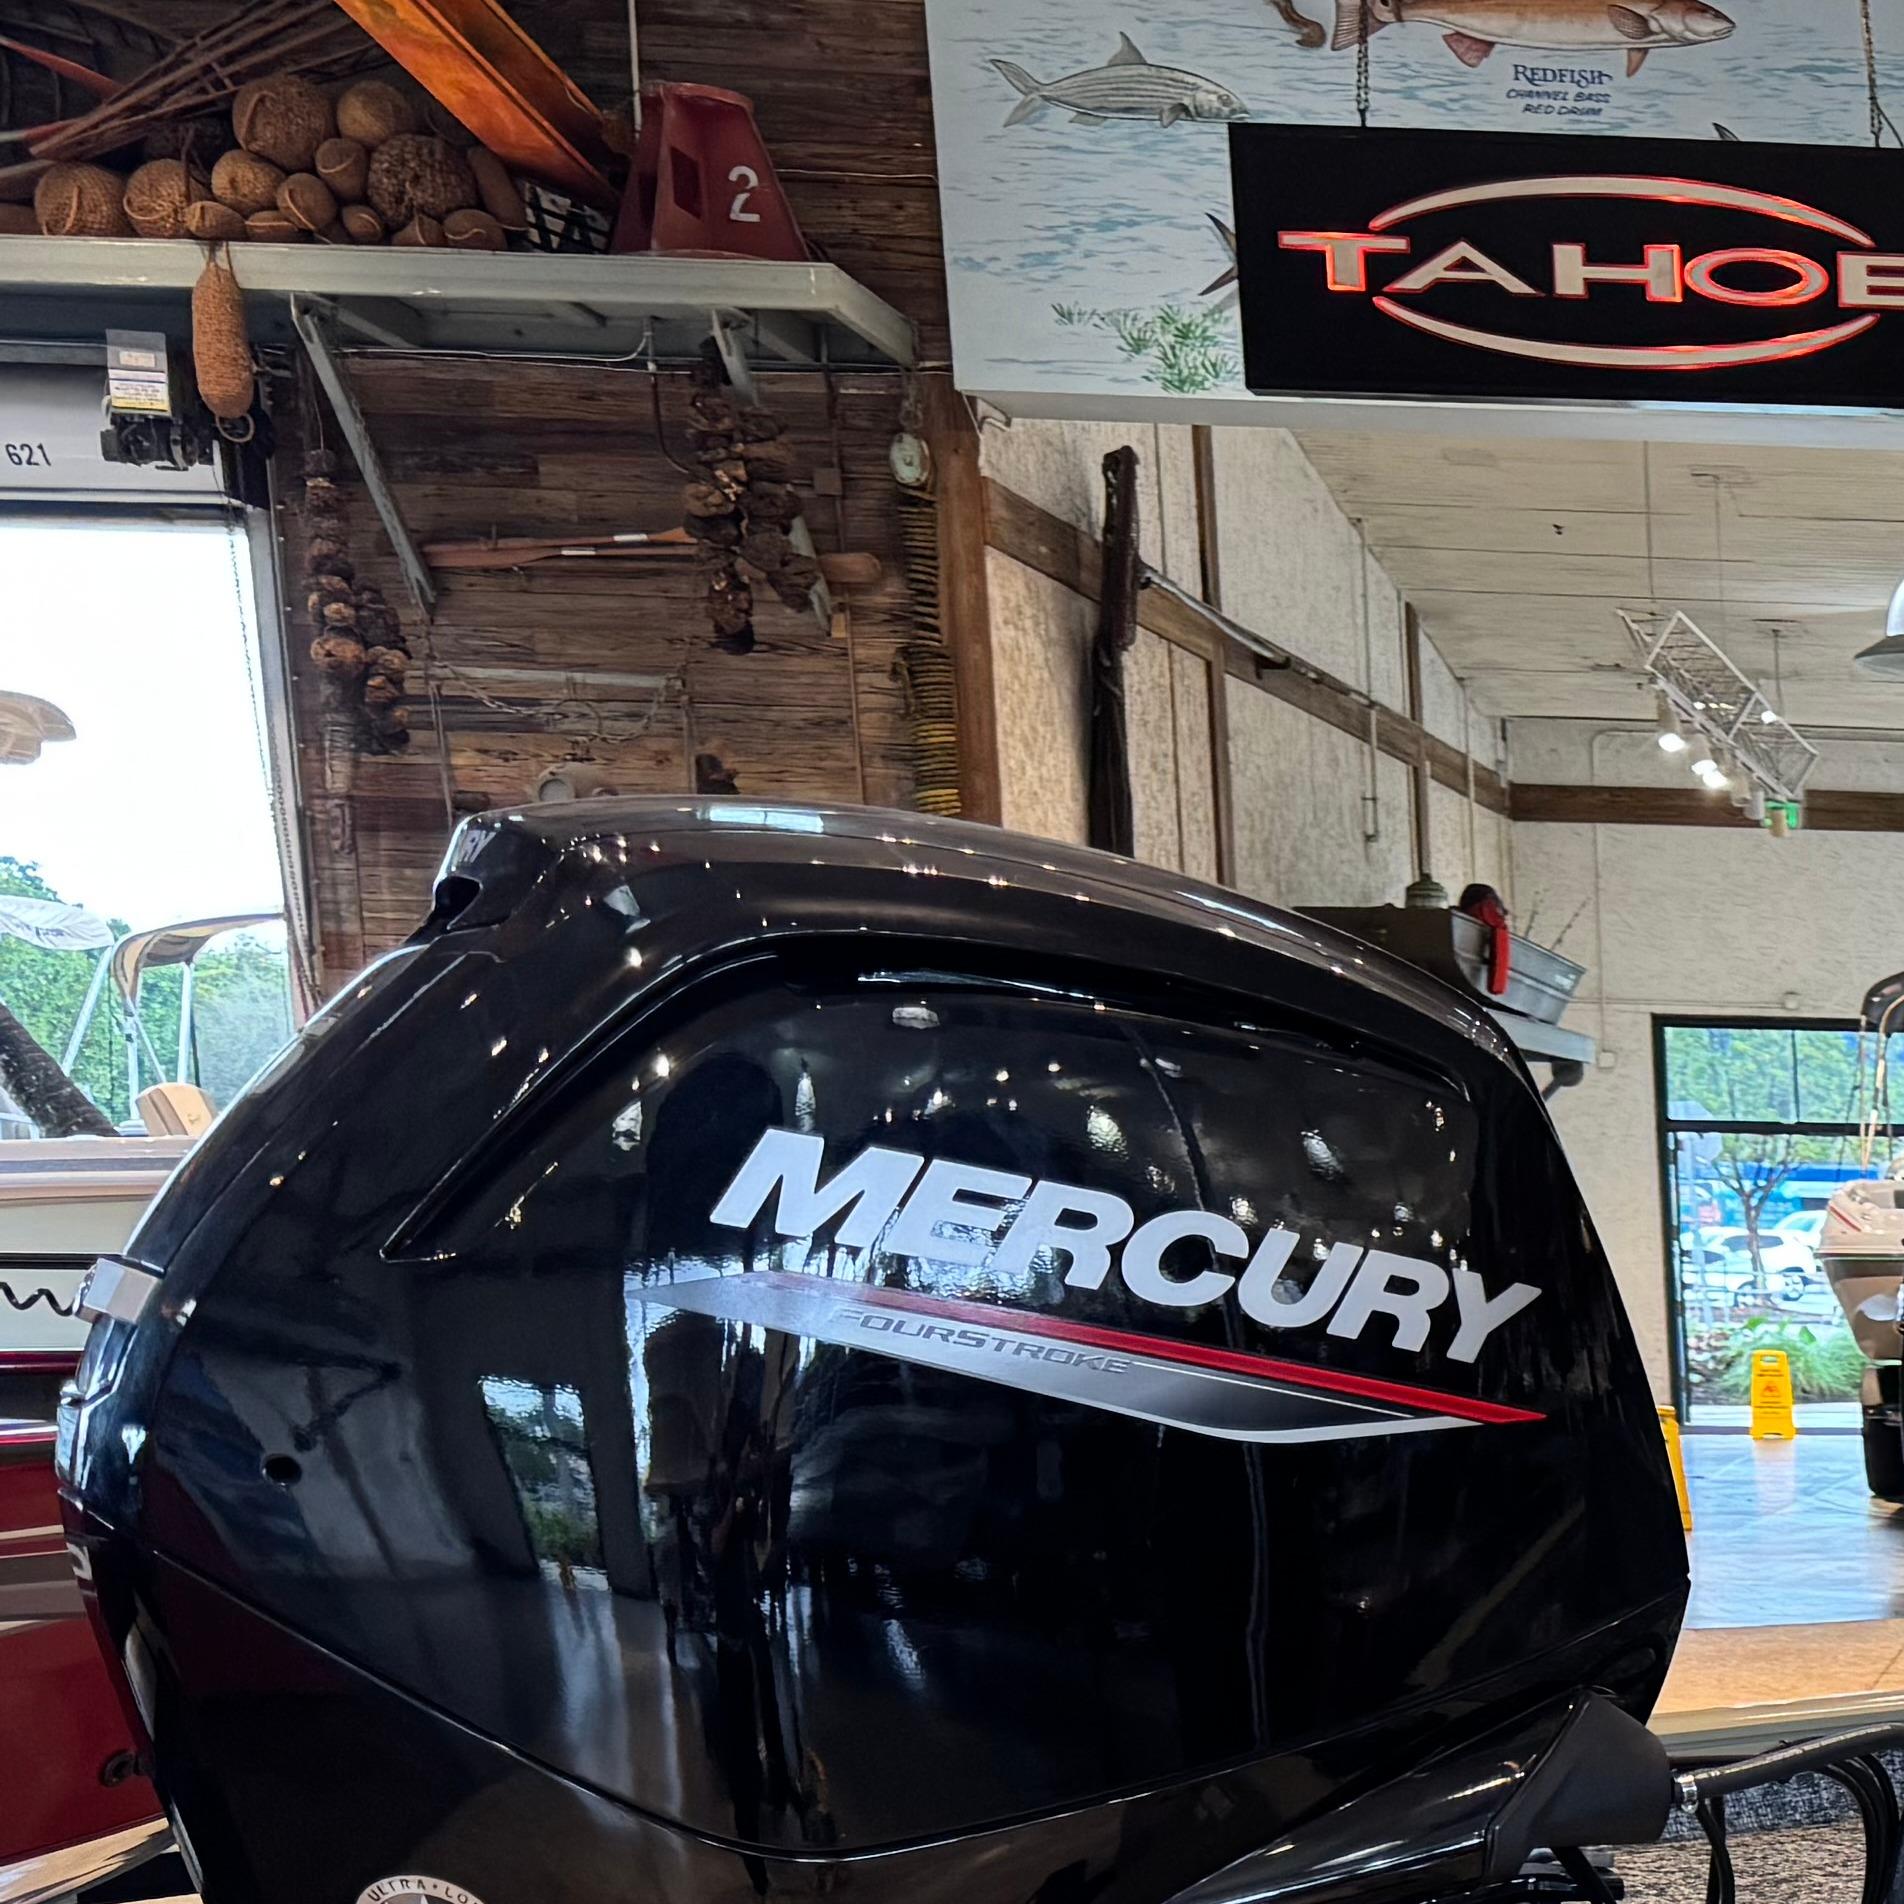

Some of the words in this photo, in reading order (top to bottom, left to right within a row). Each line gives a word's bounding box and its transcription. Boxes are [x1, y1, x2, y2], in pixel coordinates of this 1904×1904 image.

[1512, 64, 1613, 88] REDFISH
[728, 165, 760, 223] 2
[5, 442, 51, 466] 621
[710, 1129, 1541, 1362] MERCURY
[367, 1878, 427, 1903] ULTRA
